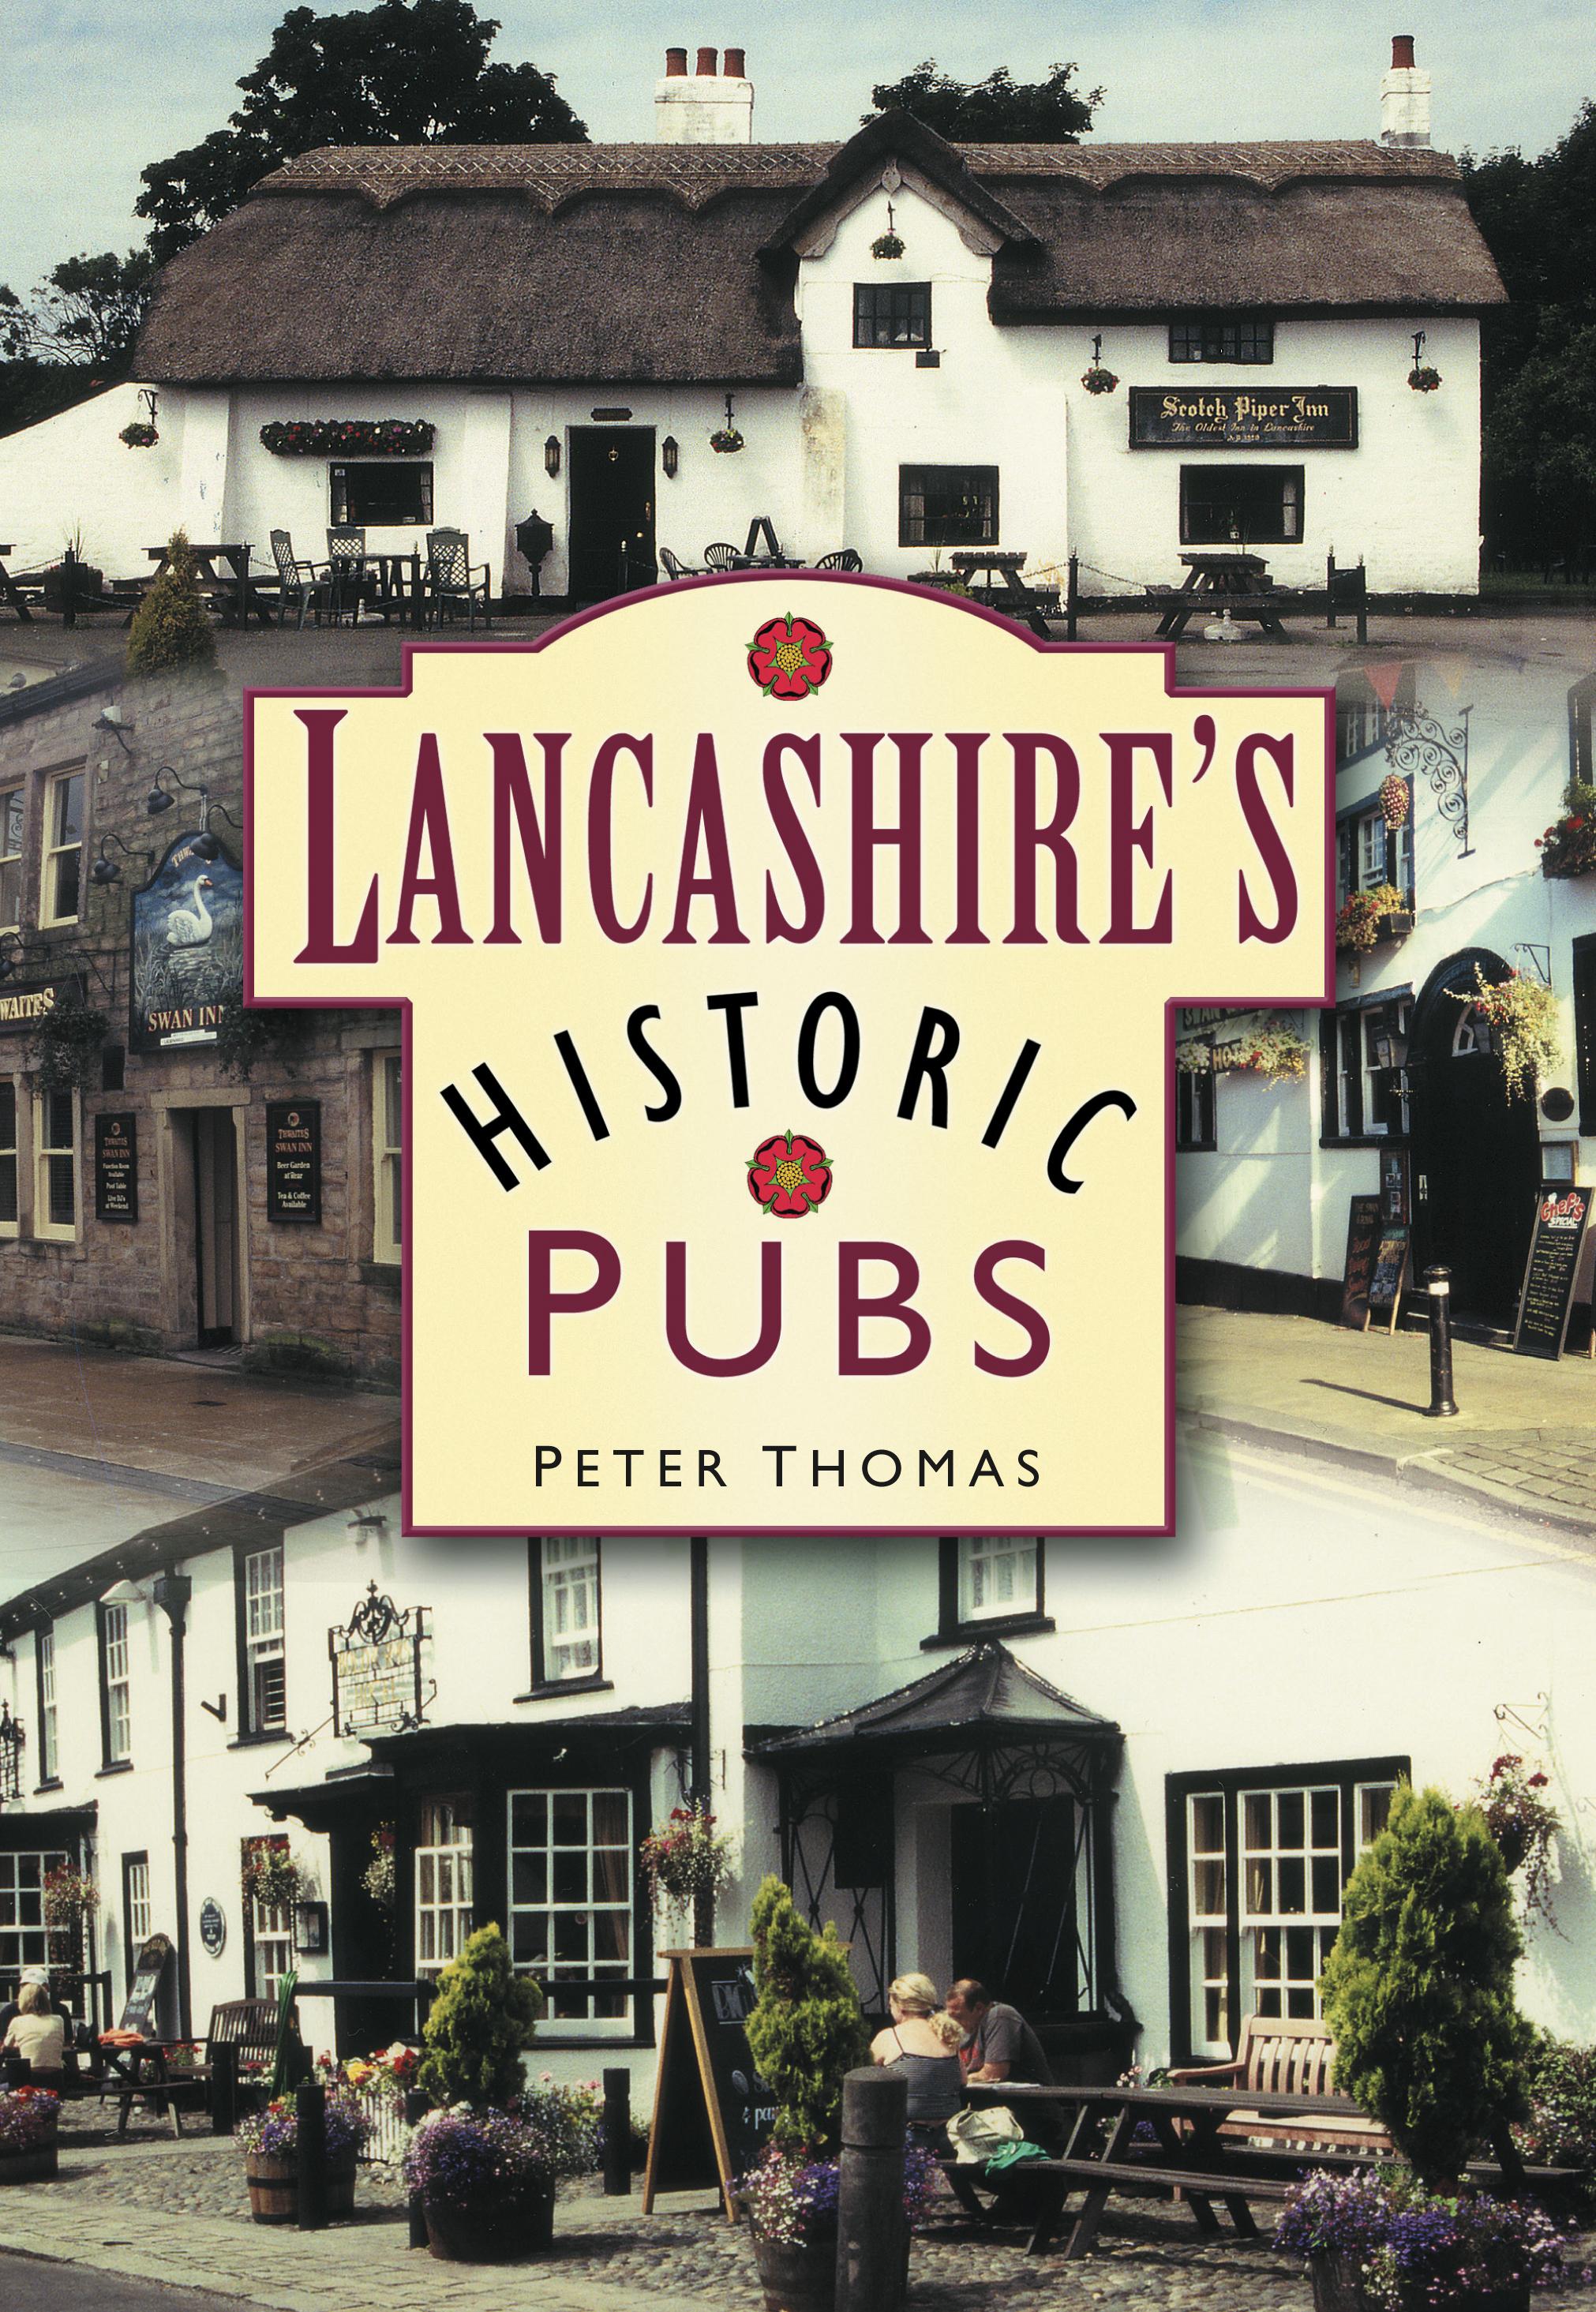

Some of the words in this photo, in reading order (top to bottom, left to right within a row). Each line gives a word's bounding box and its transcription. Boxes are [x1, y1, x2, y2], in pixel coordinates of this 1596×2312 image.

[1160, 395, 1228, 423] Scotch
[1234, 395, 1290, 422] Piper
[1291, 395, 1329, 423] Inn
[1172, 422, 1191, 433] The
[1195, 422, 1227, 432] Oldest
[1230, 422, 1246, 432] Inn
[1249, 423, 1260, 432] in
[1264, 422, 1315, 433] Lancashire
[148, 1009, 193, 1032] SWAN
[102, 1149, 118, 1158] SWAN
[119, 1149, 131, 1158] INN
[275, 1142, 297, 1152] SWAN
[298, 1142, 313, 1152] INN
[1541, 1193, 1586, 1222] Chef's
